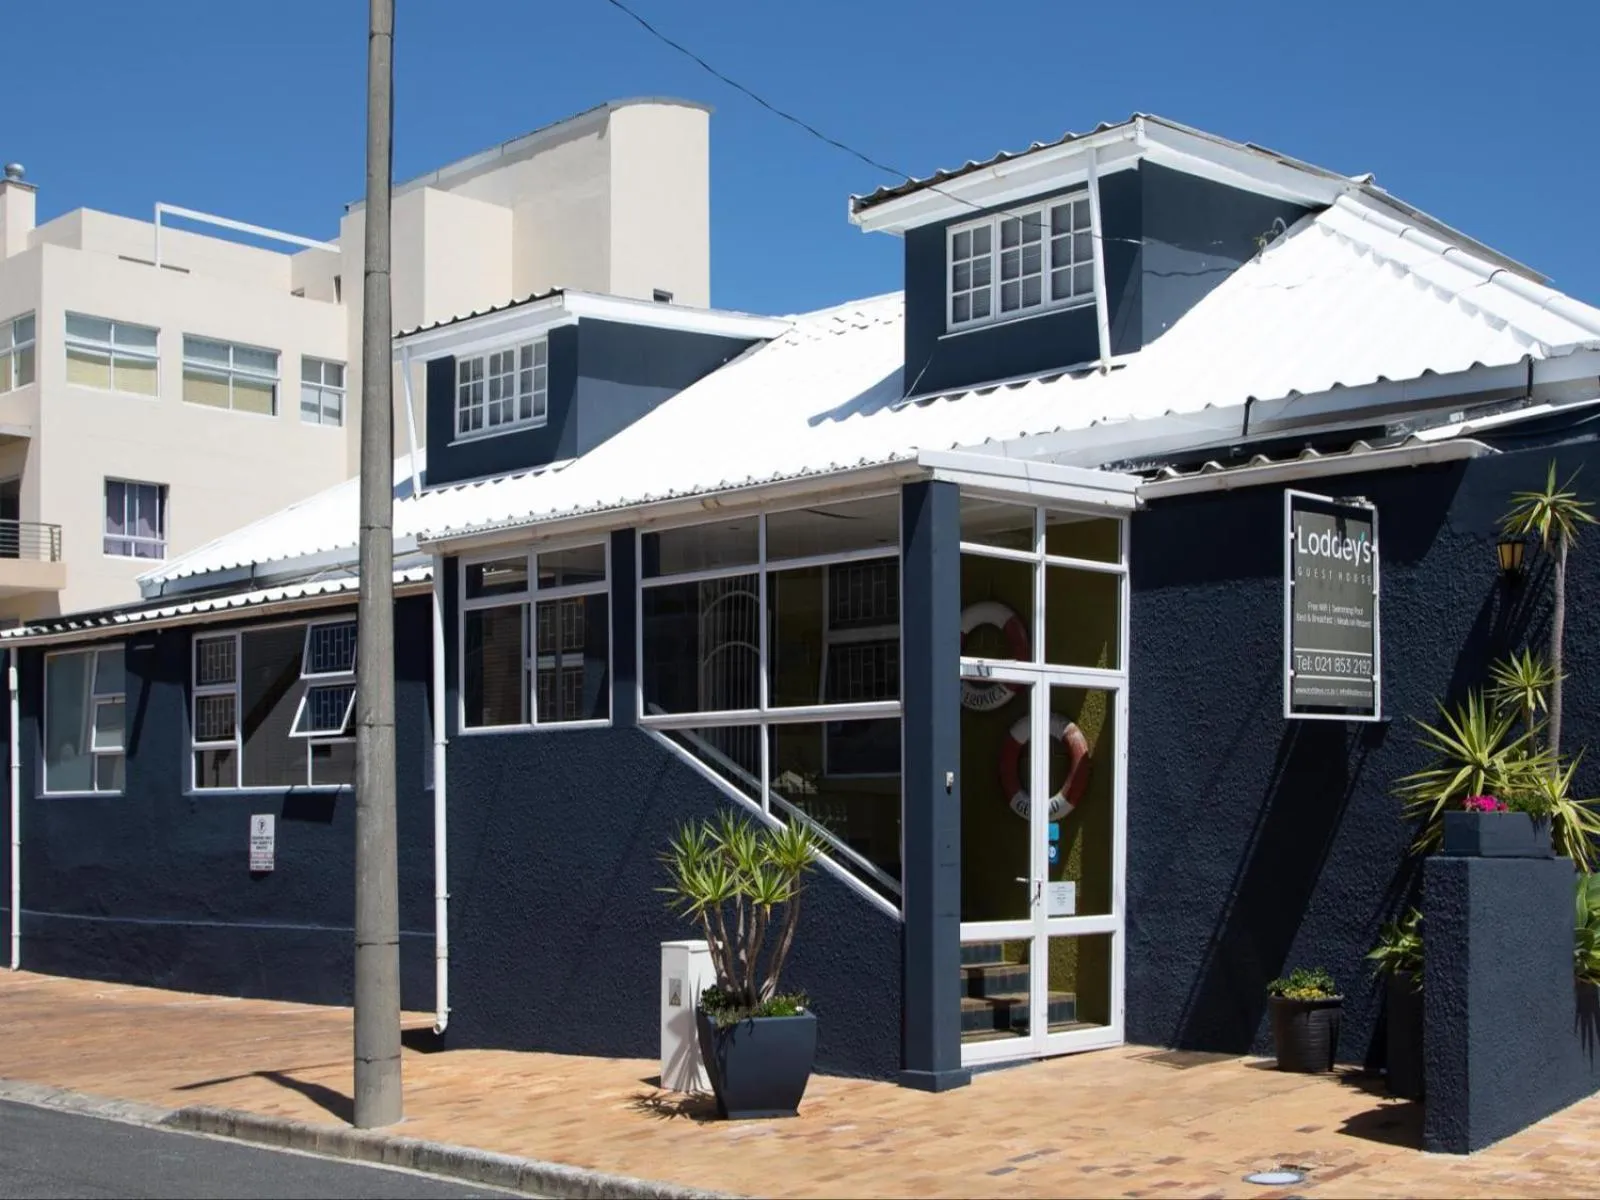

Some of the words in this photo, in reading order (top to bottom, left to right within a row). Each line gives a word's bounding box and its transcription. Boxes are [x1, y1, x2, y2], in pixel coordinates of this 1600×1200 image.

[1298, 525, 1371, 567] Loddey's
[1297, 566, 1332, 581] GUEST
[1338, 571, 1372, 586] HOUSE
[1296, 655, 1313, 671] Tel:
[1315, 656, 1332, 672] 021
[1334, 657, 1351, 673] 853
